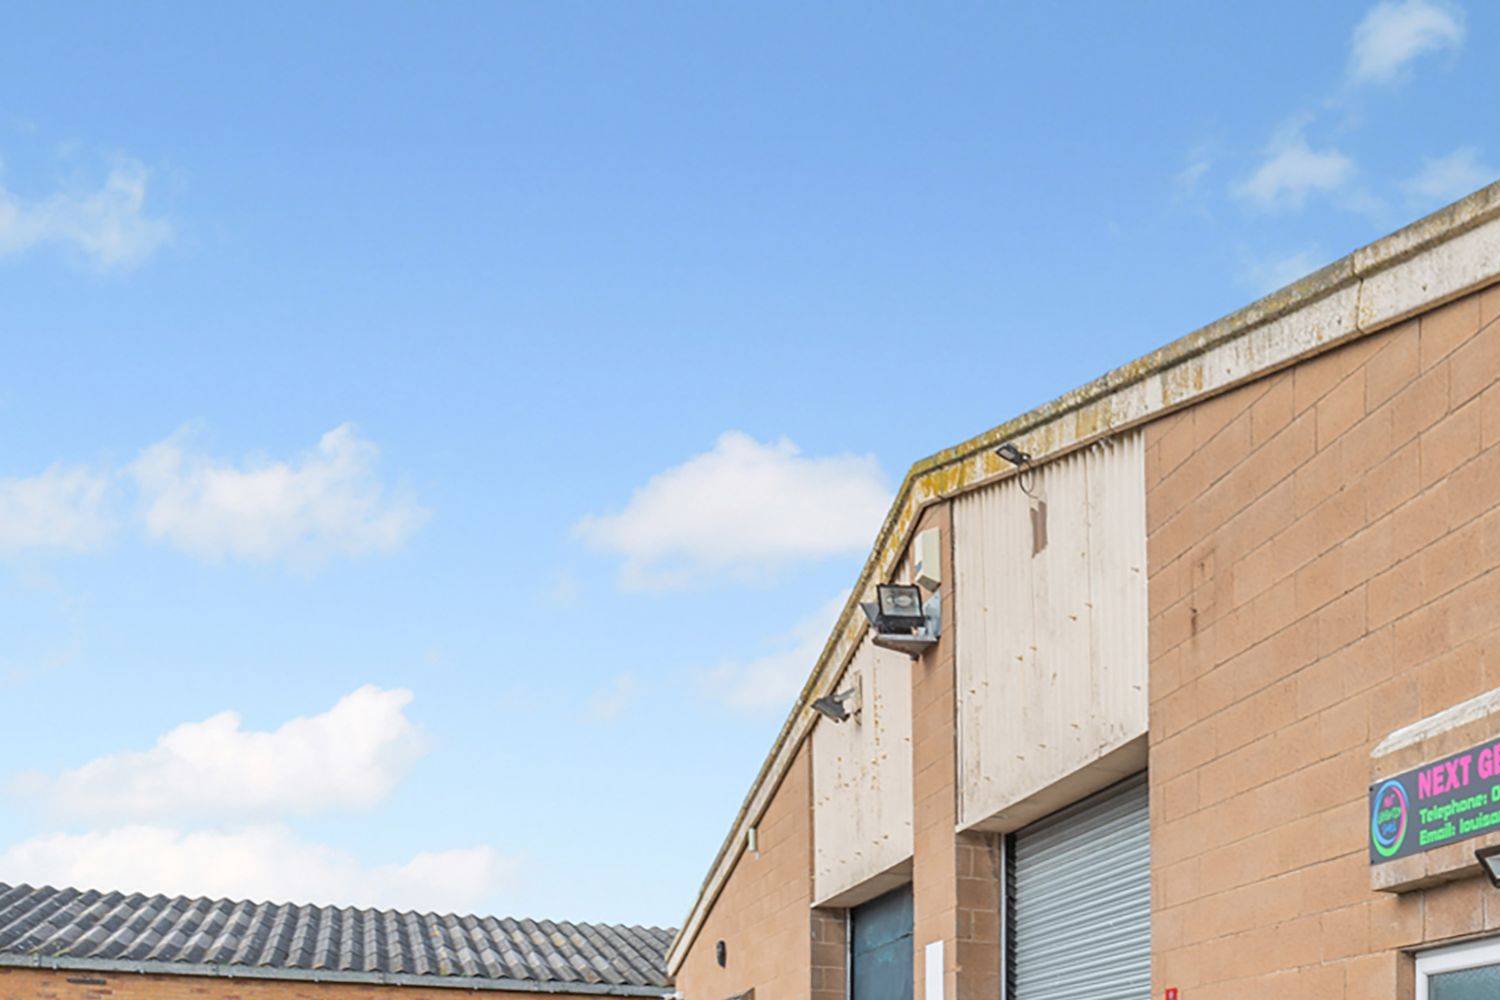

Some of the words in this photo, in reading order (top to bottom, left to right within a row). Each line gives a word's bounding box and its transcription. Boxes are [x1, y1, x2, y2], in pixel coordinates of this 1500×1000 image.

[1418, 755, 1472, 799] NEXT
[1419, 794, 1487, 824] Telephone:
[1419, 822, 1455, 845] Email:
